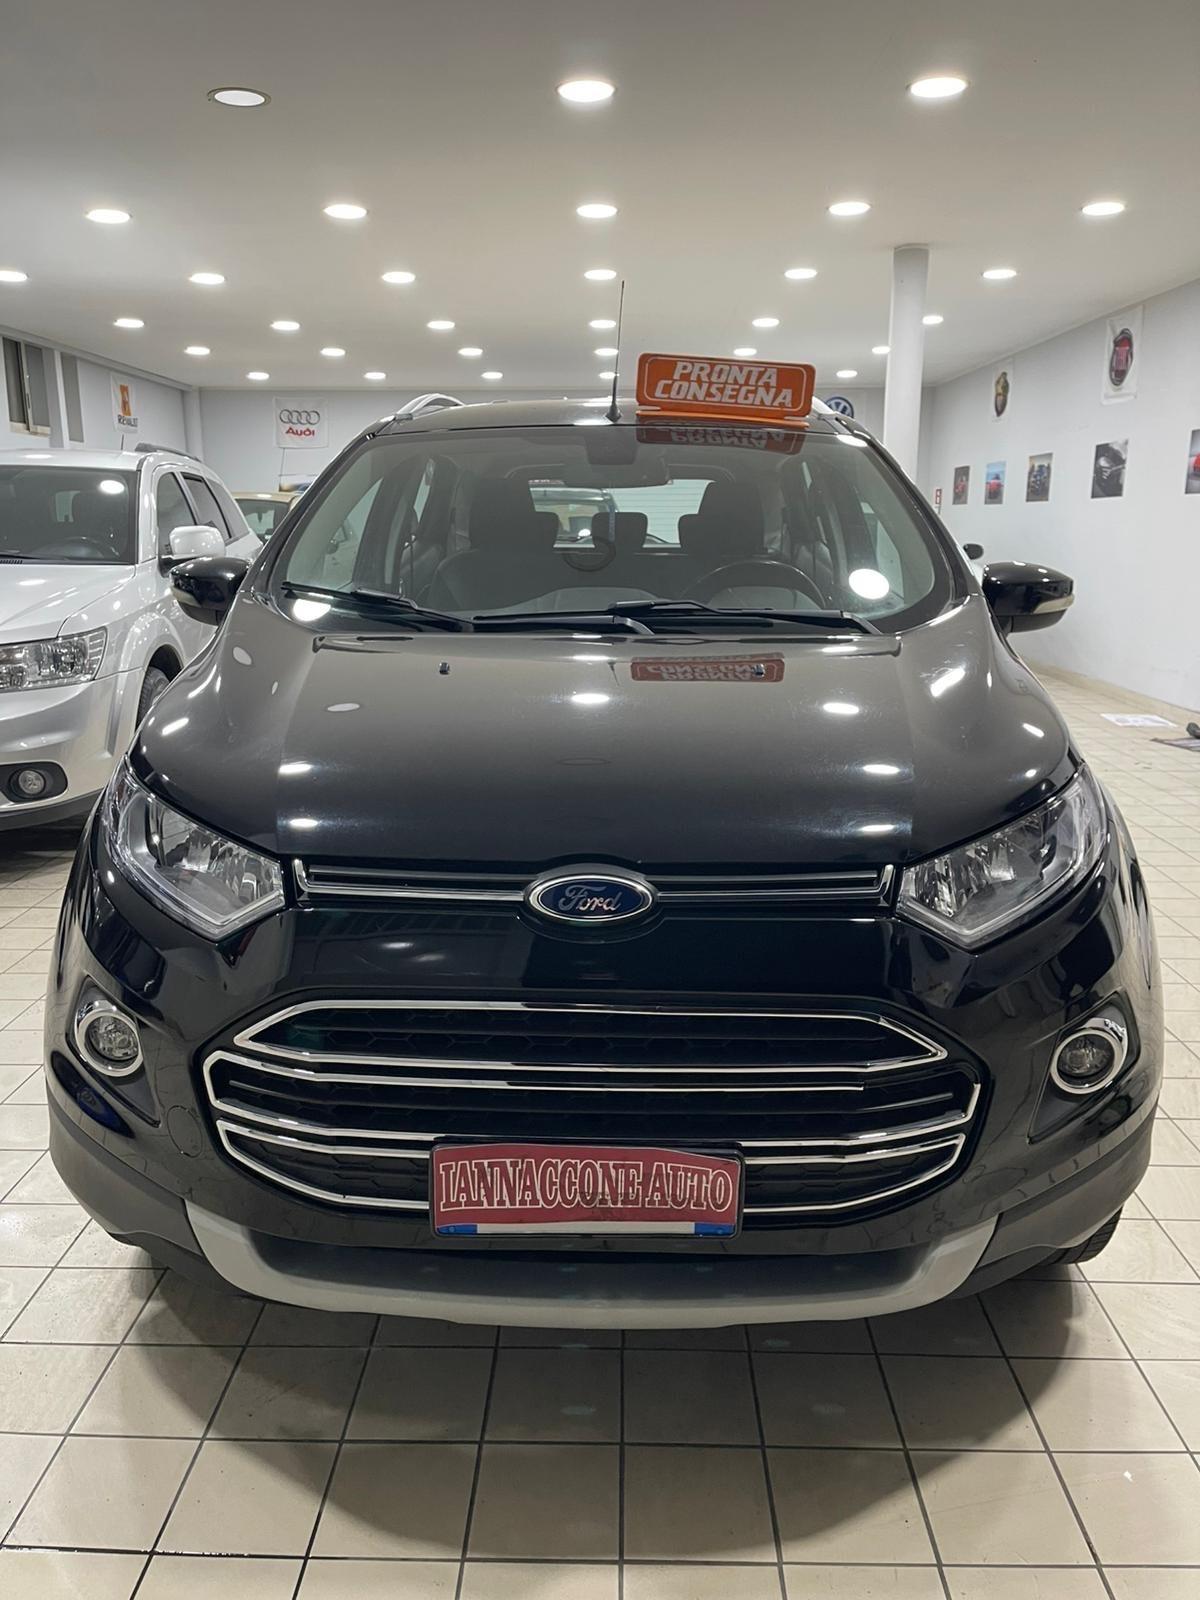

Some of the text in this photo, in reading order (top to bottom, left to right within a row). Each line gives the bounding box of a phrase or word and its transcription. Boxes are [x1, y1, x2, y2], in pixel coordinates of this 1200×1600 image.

[673, 361, 778, 387] PRONTA
[654, 379, 793, 408] CONSEGNA
[558, 884, 623, 911] Ford
[440, 1158, 733, 1213] IANNACCONE AUTO
